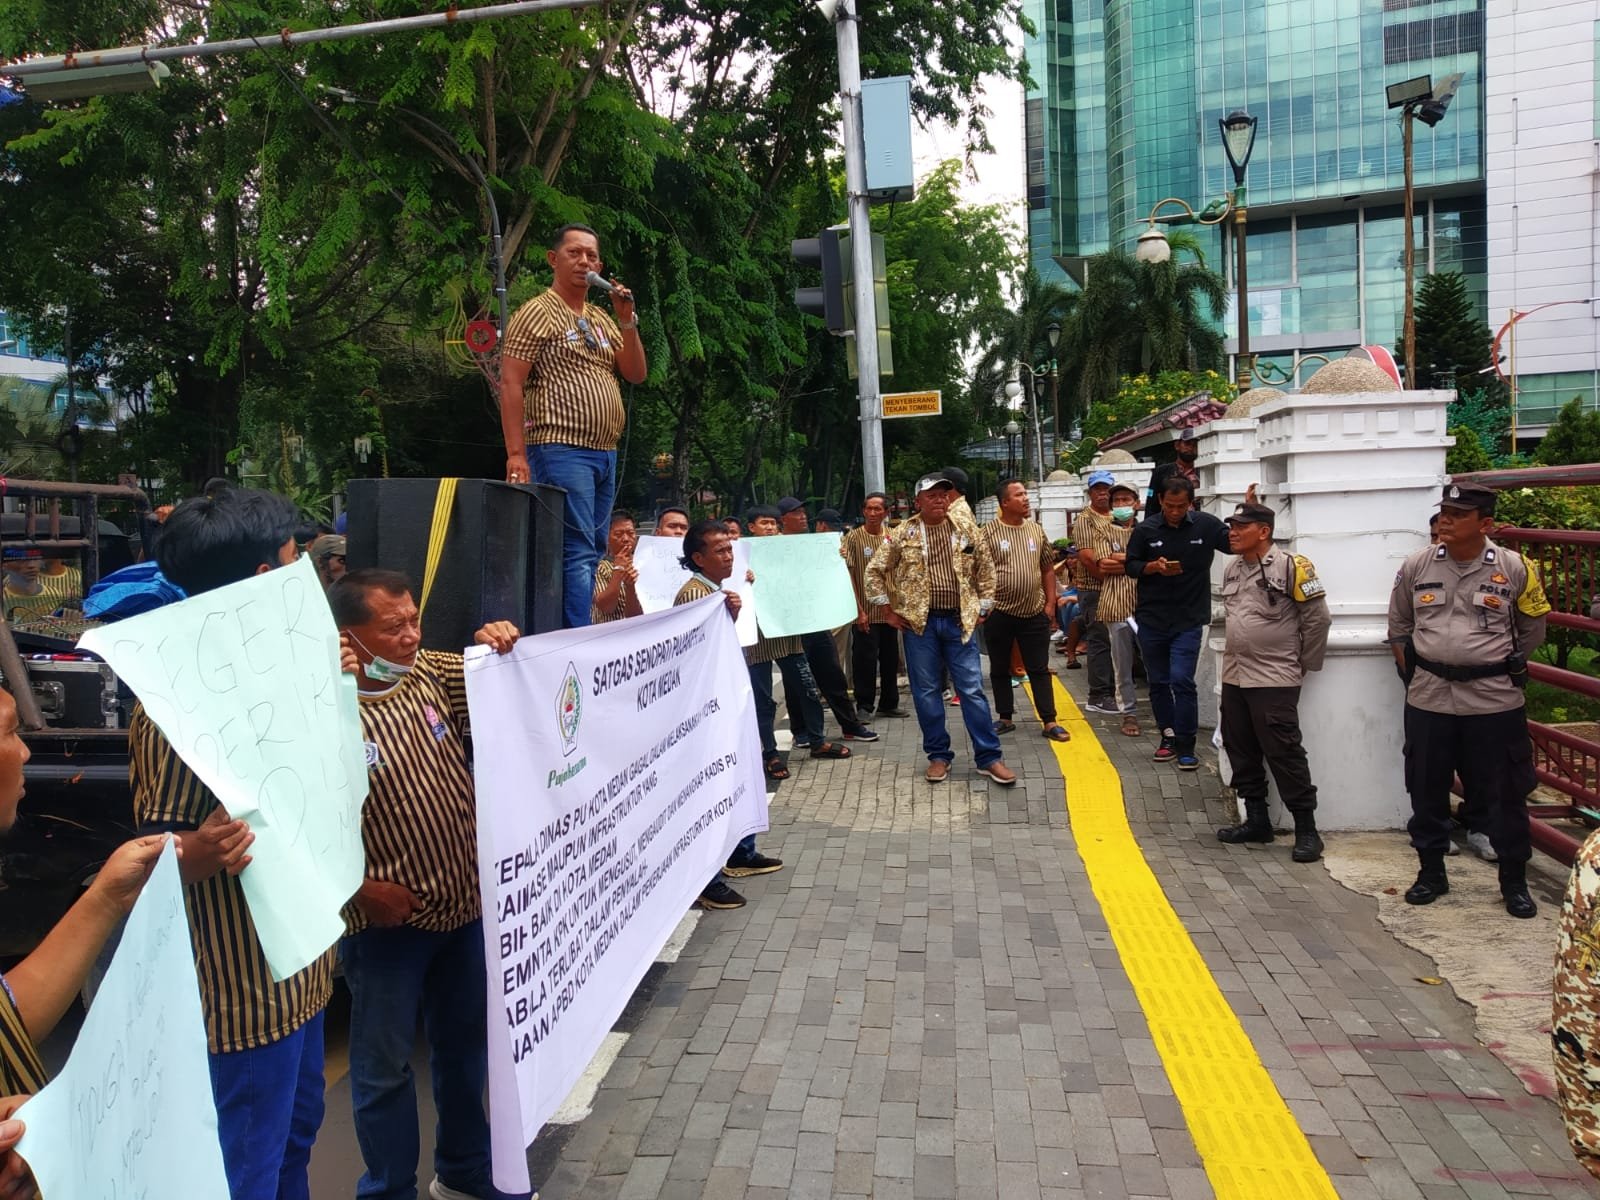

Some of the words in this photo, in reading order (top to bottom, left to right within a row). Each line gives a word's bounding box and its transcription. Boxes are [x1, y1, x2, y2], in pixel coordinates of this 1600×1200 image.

[885, 396, 936, 406] MENYEBERANG
[885, 405, 908, 413] TEKAN
[910, 403, 937, 411] TOMBOL
[1480, 584, 1511, 599] POLRI
[593, 653, 633, 696] SATGAS
[634, 638, 673, 677] SENOPATI
[671, 626, 705, 658] PUJAKEA
[637, 681, 656, 713] KOTA
[659, 665, 681, 698] MEDAN
[540, 813, 571, 855] DINAS
[573, 803, 587, 830] PU
[588, 787, 607, 819] KOTA
[607, 767, 629, 801] MEDAN
[629, 752, 649, 781] GAGAL
[649, 738, 666, 764] DALAM
[666, 711, 701, 750] MELAKSANAK
[701, 697, 720, 719] OYEK
[547, 832, 586, 883] MAUPUN
[588, 784, 642, 848] INFRASTRUKTUR
[642, 770, 658, 797] YANG
[553, 912, 569, 952] KPK
[568, 886, 597, 929] UNTUK
[637, 808, 667, 855] MENGAUDIT
[667, 801, 678, 822] DAN
[677, 771, 704, 809] MENANGKAP
[704, 758, 724, 780] KADIS
[725, 752, 737, 769] PU
[531, 901, 553, 940] BAIK
[554, 887, 562, 912] DI
[562, 863, 587, 897] KOTA
[588, 836, 617, 878] MEDAN
[551, 979, 574, 1029] APBD
[574, 954, 595, 991] KOTA
[594, 921, 619, 963] MEDAN
[619, 888, 642, 930] DALAM
[641, 853, 673, 899] PEKERJAAN
[713, 796, 733, 820] KOTA
[548, 927, 584, 993] TERLIBAT
[584, 897, 610, 942] DALAM
